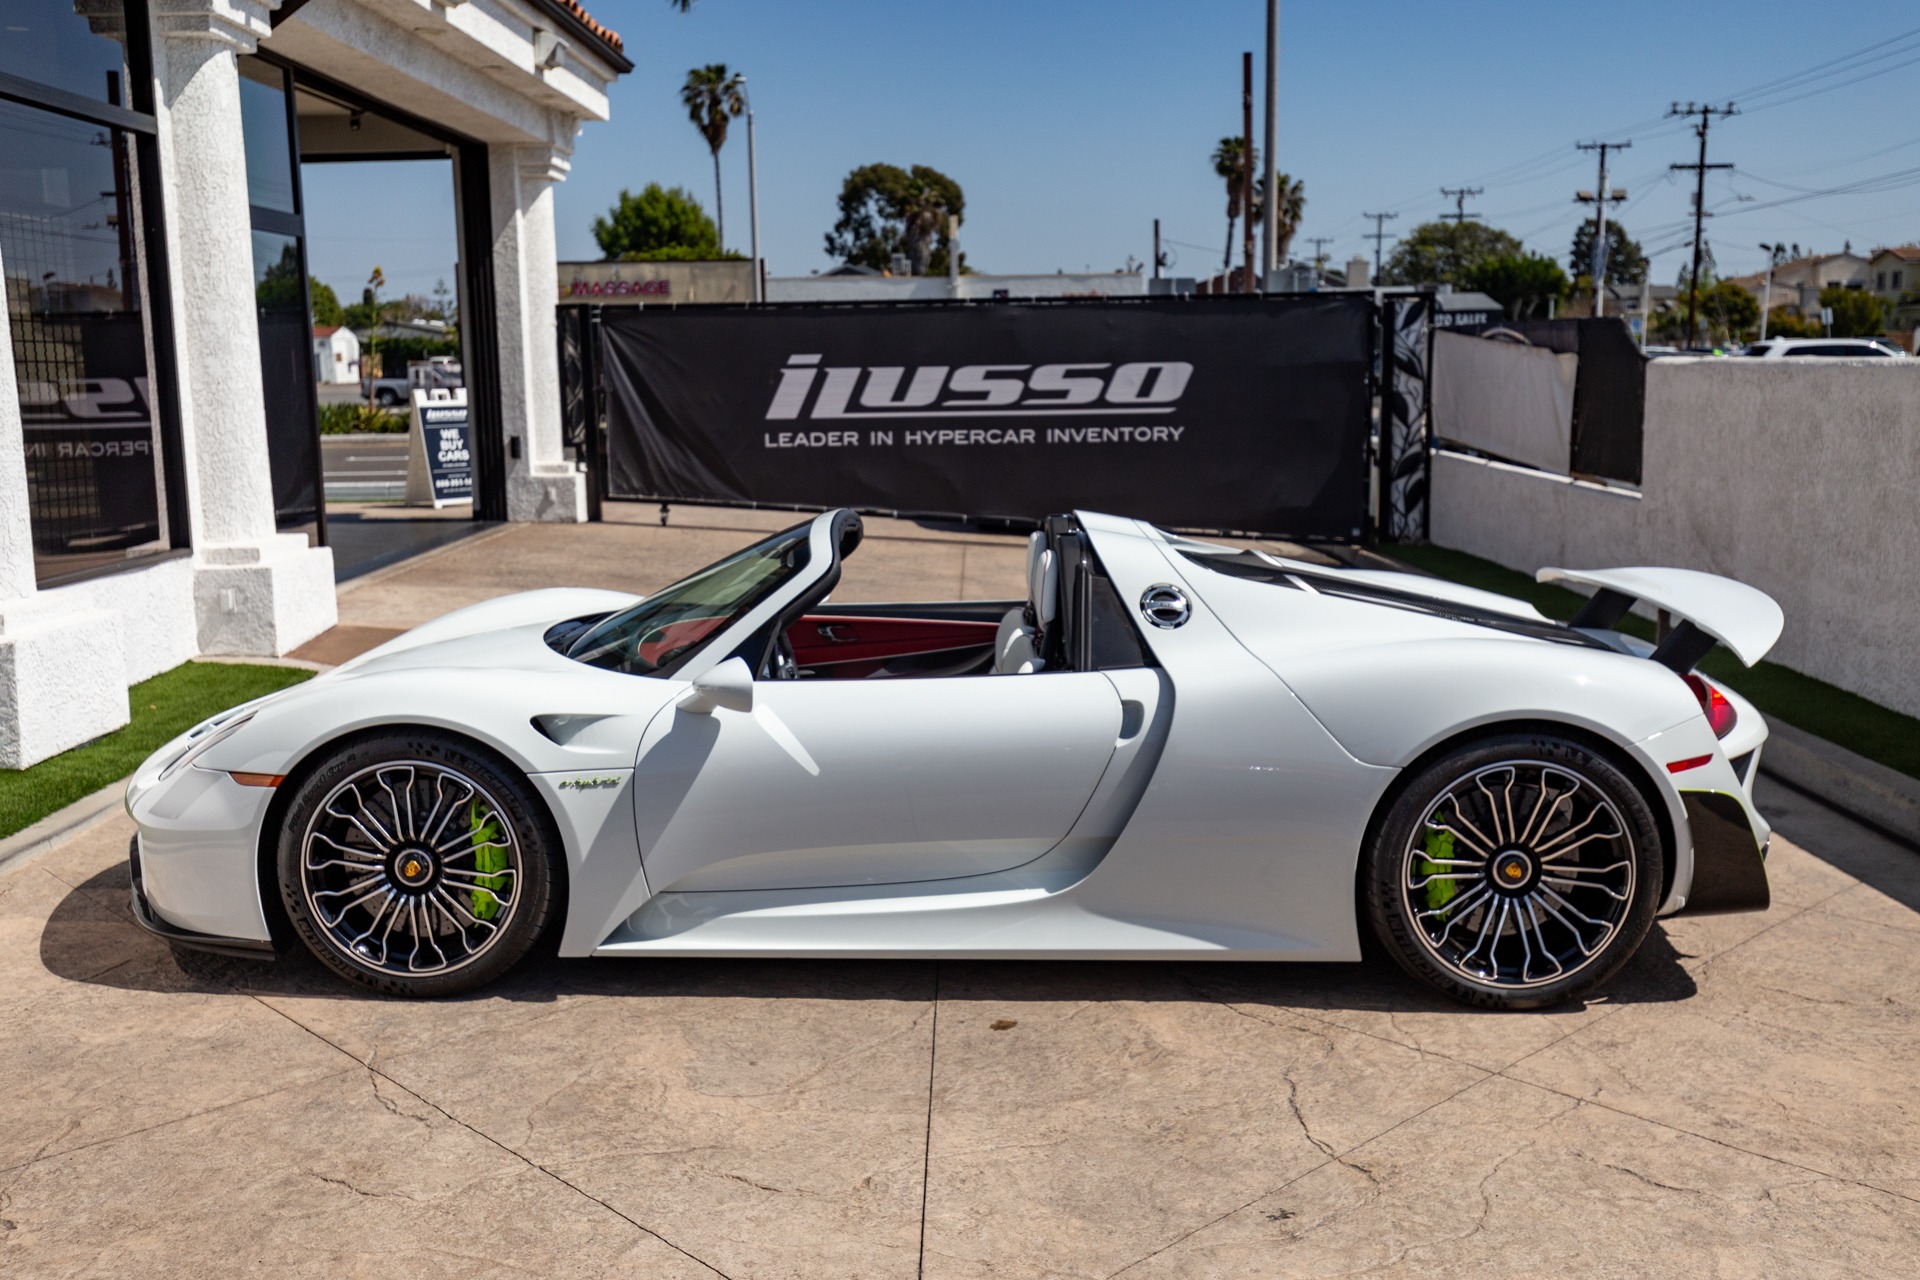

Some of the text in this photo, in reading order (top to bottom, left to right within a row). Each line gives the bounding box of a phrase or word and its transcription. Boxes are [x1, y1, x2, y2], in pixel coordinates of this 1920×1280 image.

[572, 279, 670, 296] MASSAGE
[440, 428, 459, 440] WE
[765, 426, 1185, 448] LEADER IN HYPERCAR INVENTORY
[440, 439, 464, 451] BUY
[438, 449, 470, 462] CARS
[462, 758, 526, 820] MICHELIN
[297, 917, 359, 980] MICHELIN
